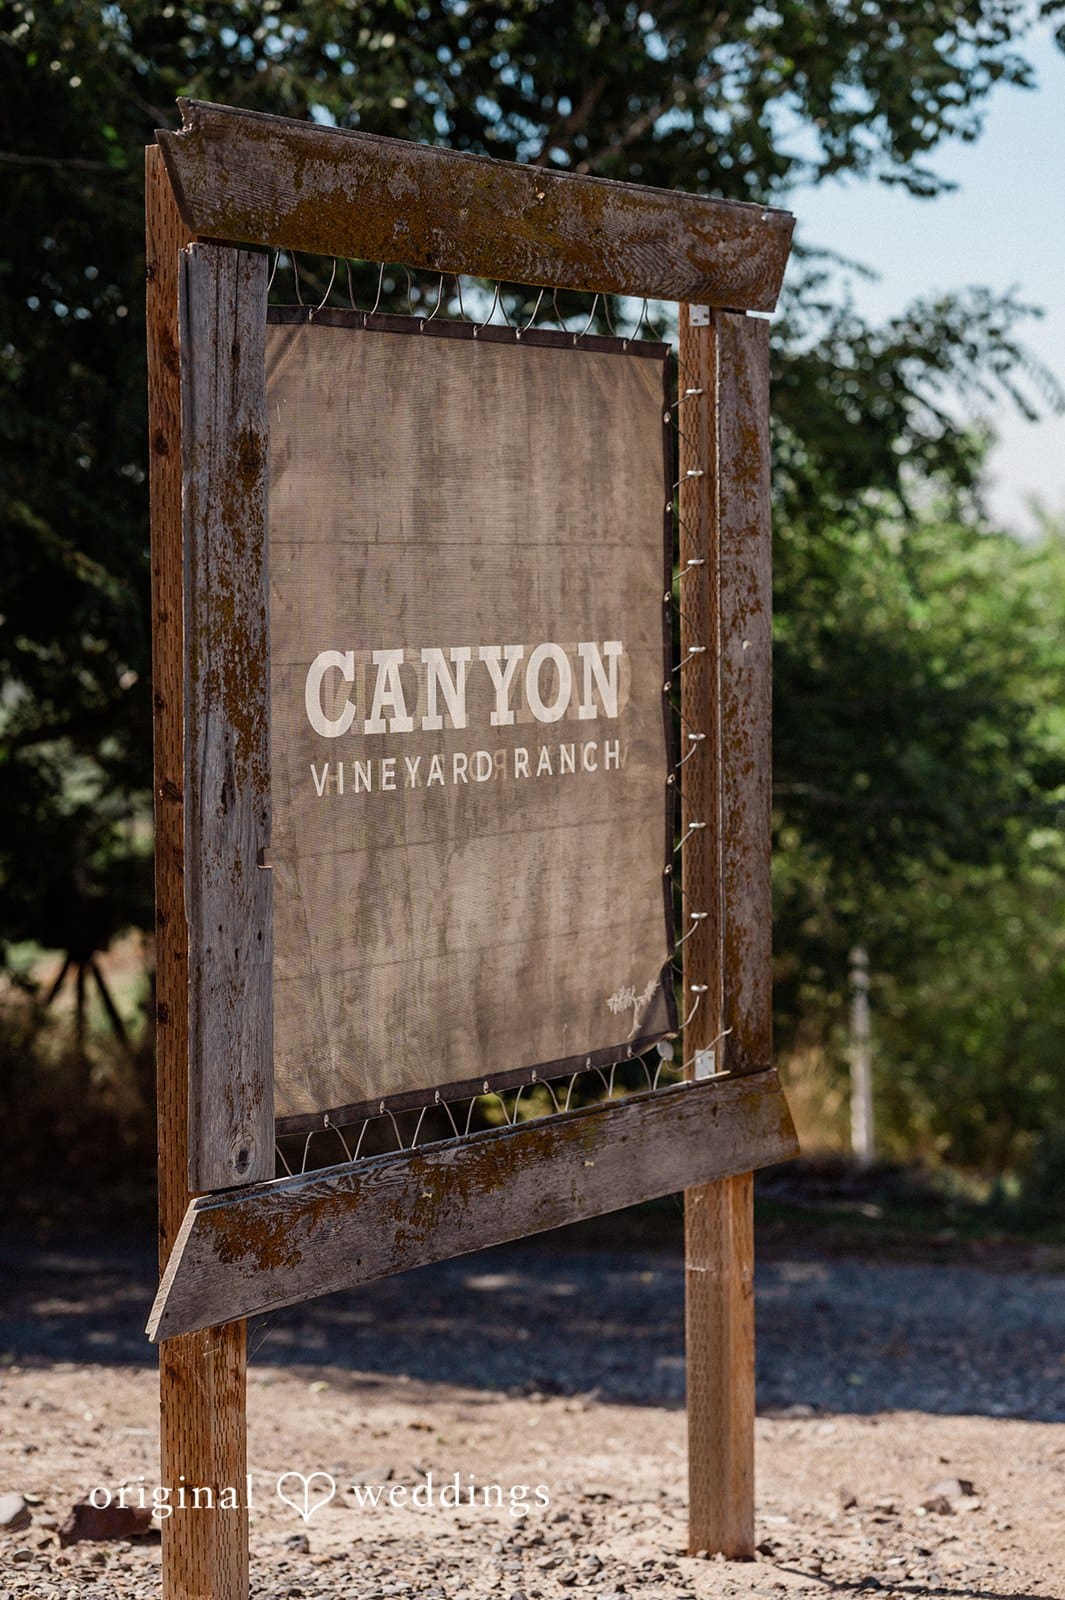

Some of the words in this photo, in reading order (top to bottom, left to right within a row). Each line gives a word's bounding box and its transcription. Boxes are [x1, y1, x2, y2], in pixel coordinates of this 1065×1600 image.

[304, 640, 623, 738] CANYON
[310, 751, 494, 797] VINEYARD
[513, 740, 620, 779] RANCH
